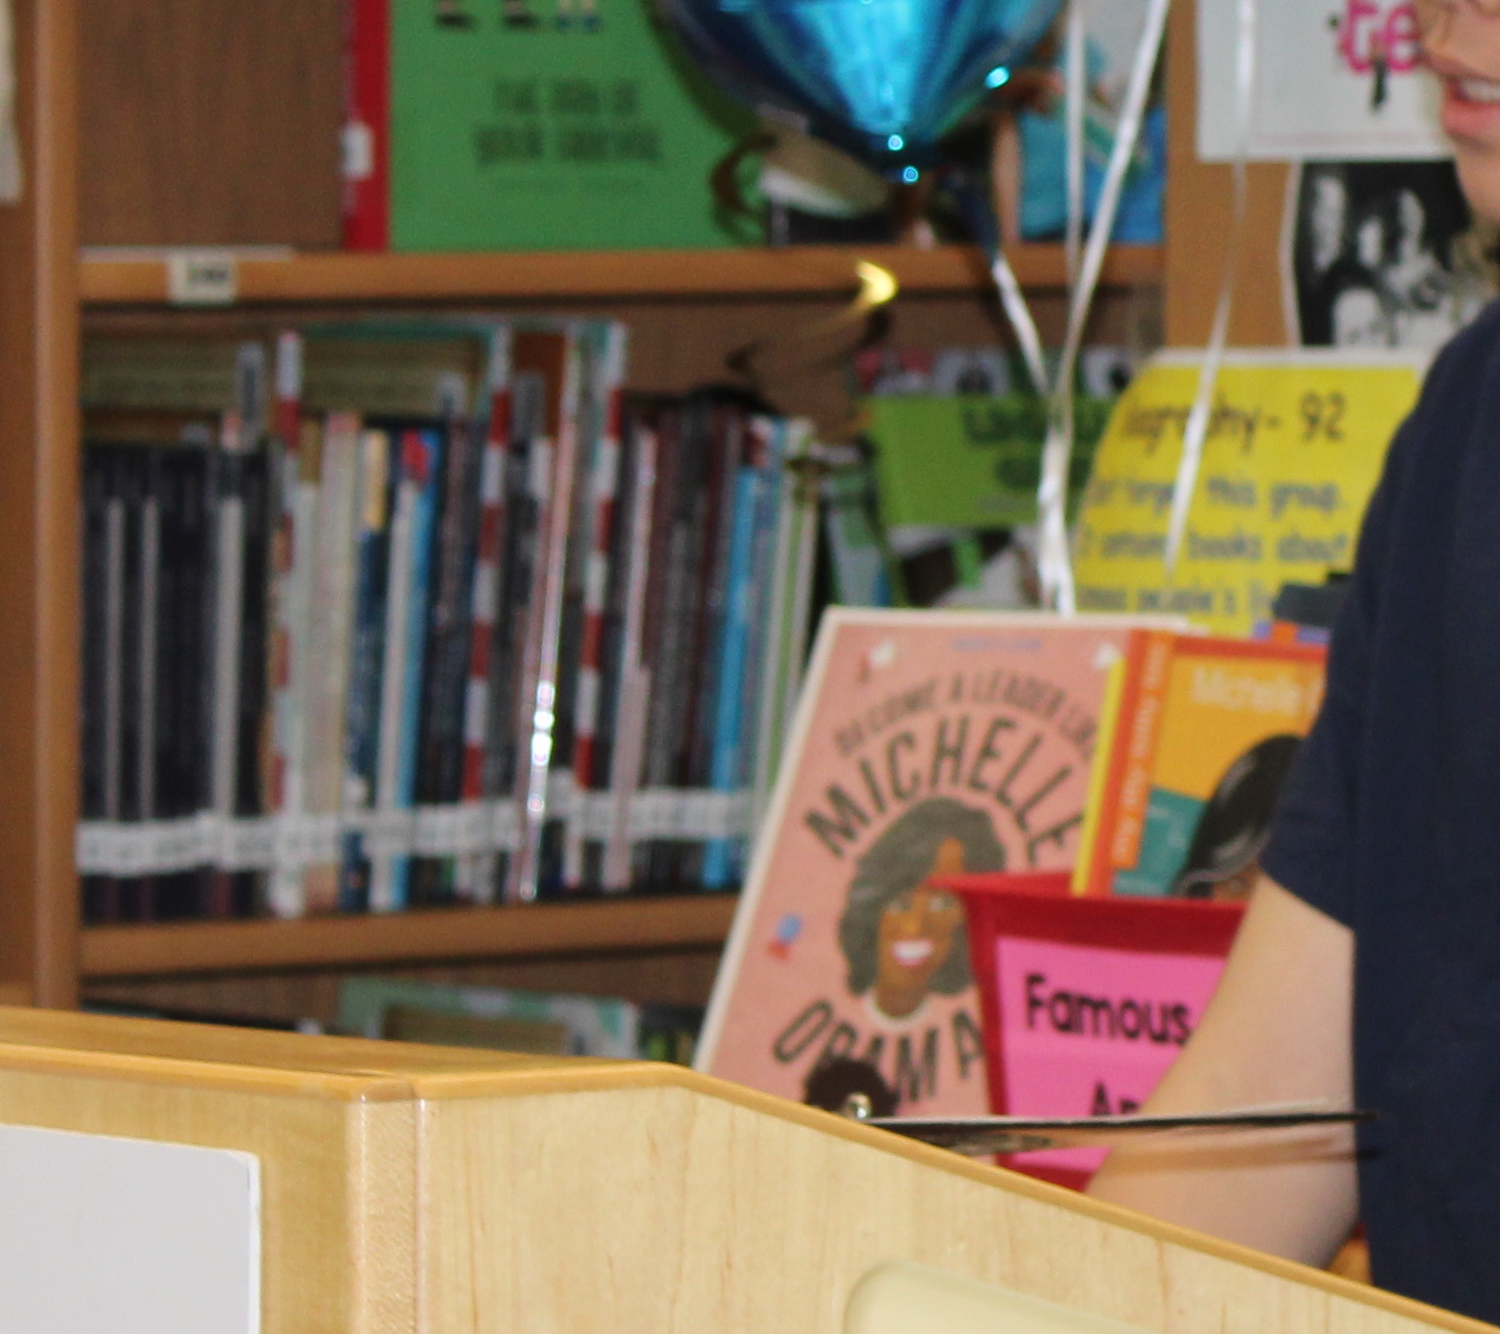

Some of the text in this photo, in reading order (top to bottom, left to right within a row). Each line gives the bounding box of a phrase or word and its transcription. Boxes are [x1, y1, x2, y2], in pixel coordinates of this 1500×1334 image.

[1299, 390, 1346, 442] 92
[805, 714, 1085, 866] MICHELLE
[1027, 972, 1195, 1048] Famous
